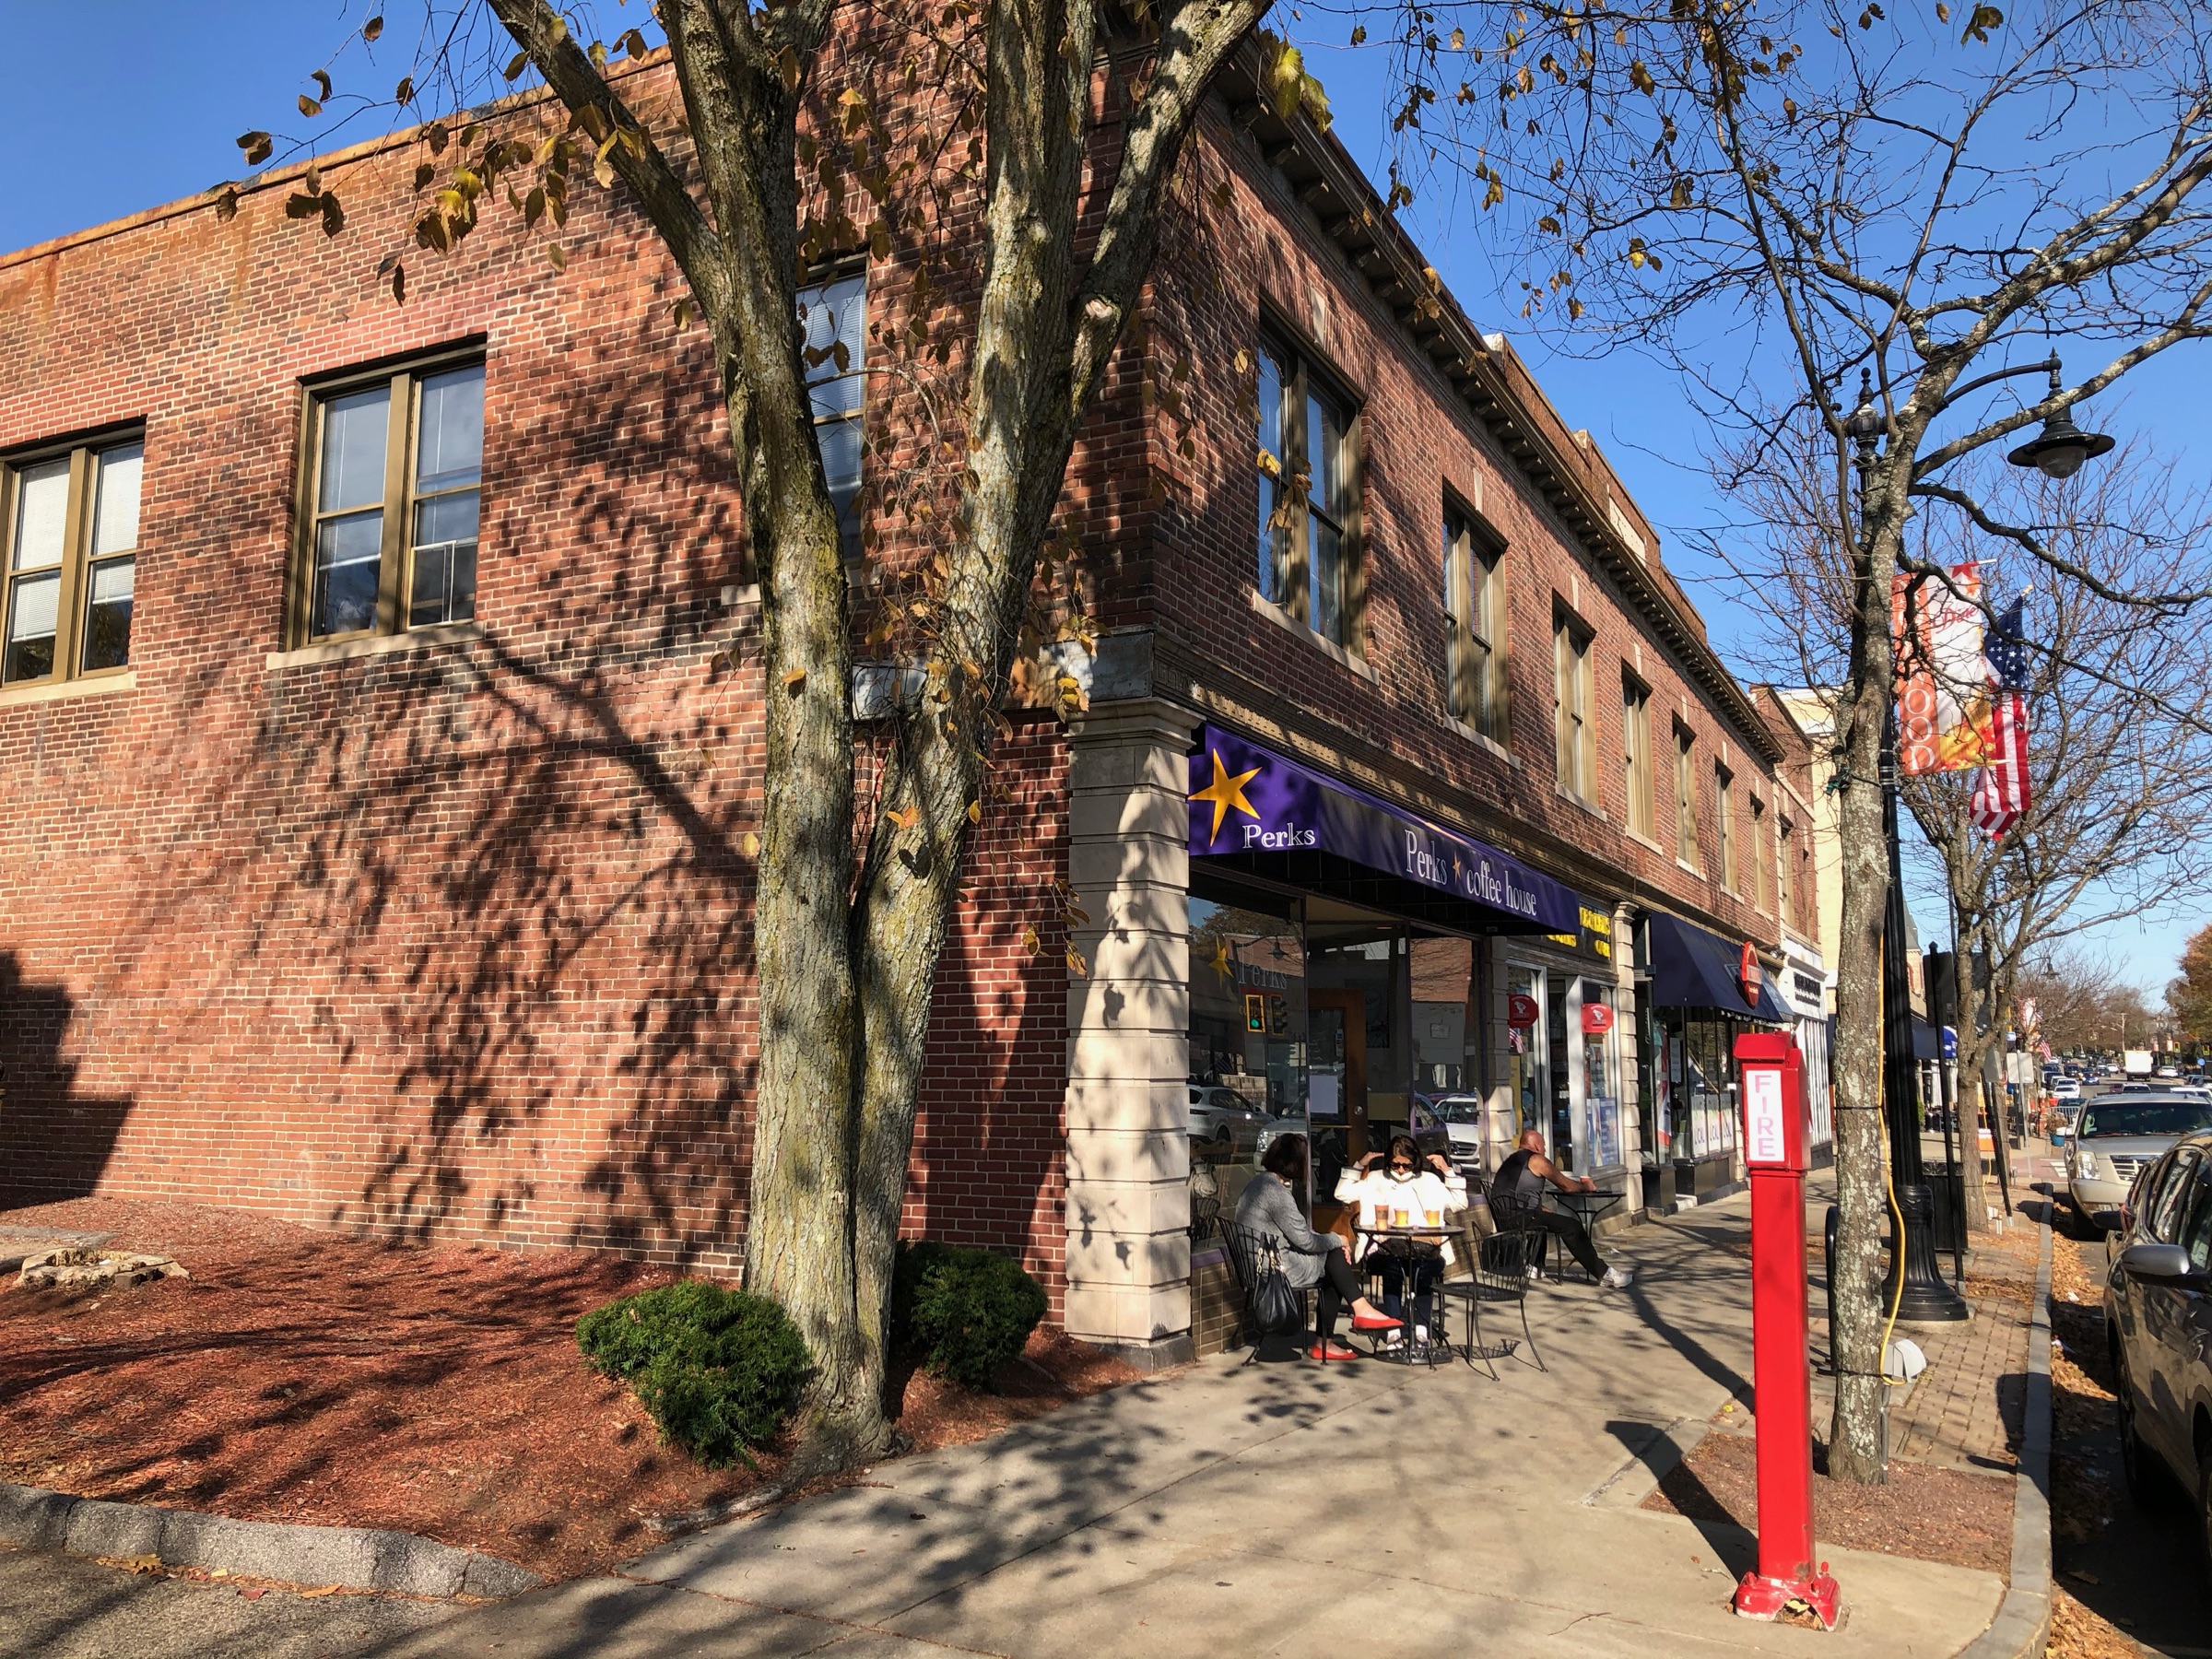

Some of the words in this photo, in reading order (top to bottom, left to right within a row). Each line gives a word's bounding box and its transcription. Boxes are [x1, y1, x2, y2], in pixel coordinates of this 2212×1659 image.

[1241, 822, 1316, 849] Perks
[1405, 830, 1448, 886] Perks
[1466, 860, 1502, 904] coffee
[1505, 870, 1537, 916] house
[1238, 942, 1288, 990] Perks
[1754, 1075, 1776, 1157] FIRE
